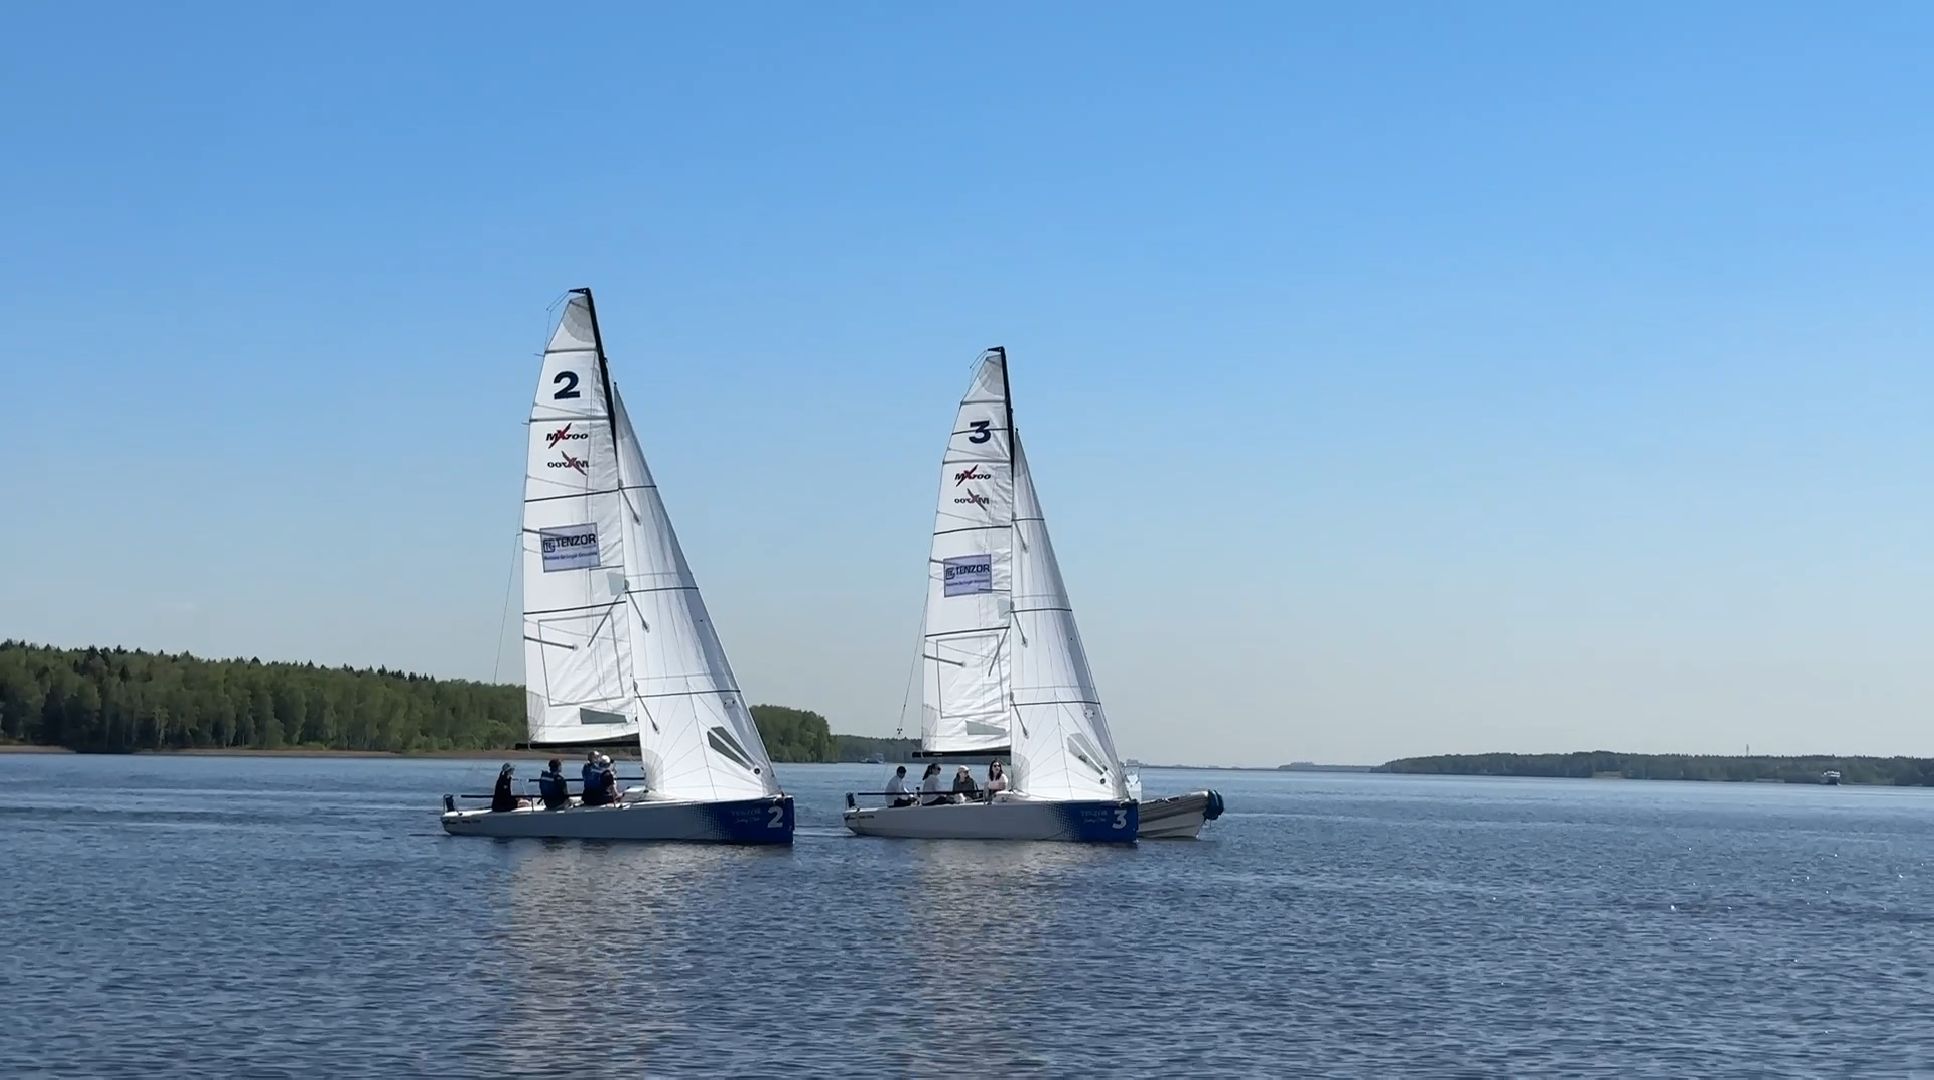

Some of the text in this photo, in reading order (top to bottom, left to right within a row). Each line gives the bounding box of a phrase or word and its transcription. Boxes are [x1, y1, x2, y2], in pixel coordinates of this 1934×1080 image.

[553, 371, 581, 400] 2
[968, 420, 992, 444] 3
[555, 533, 597, 548] TENZOR
[955, 563, 990, 575] TENZOR
[767, 806, 784, 828] 2
[1112, 810, 1127, 829] 3
